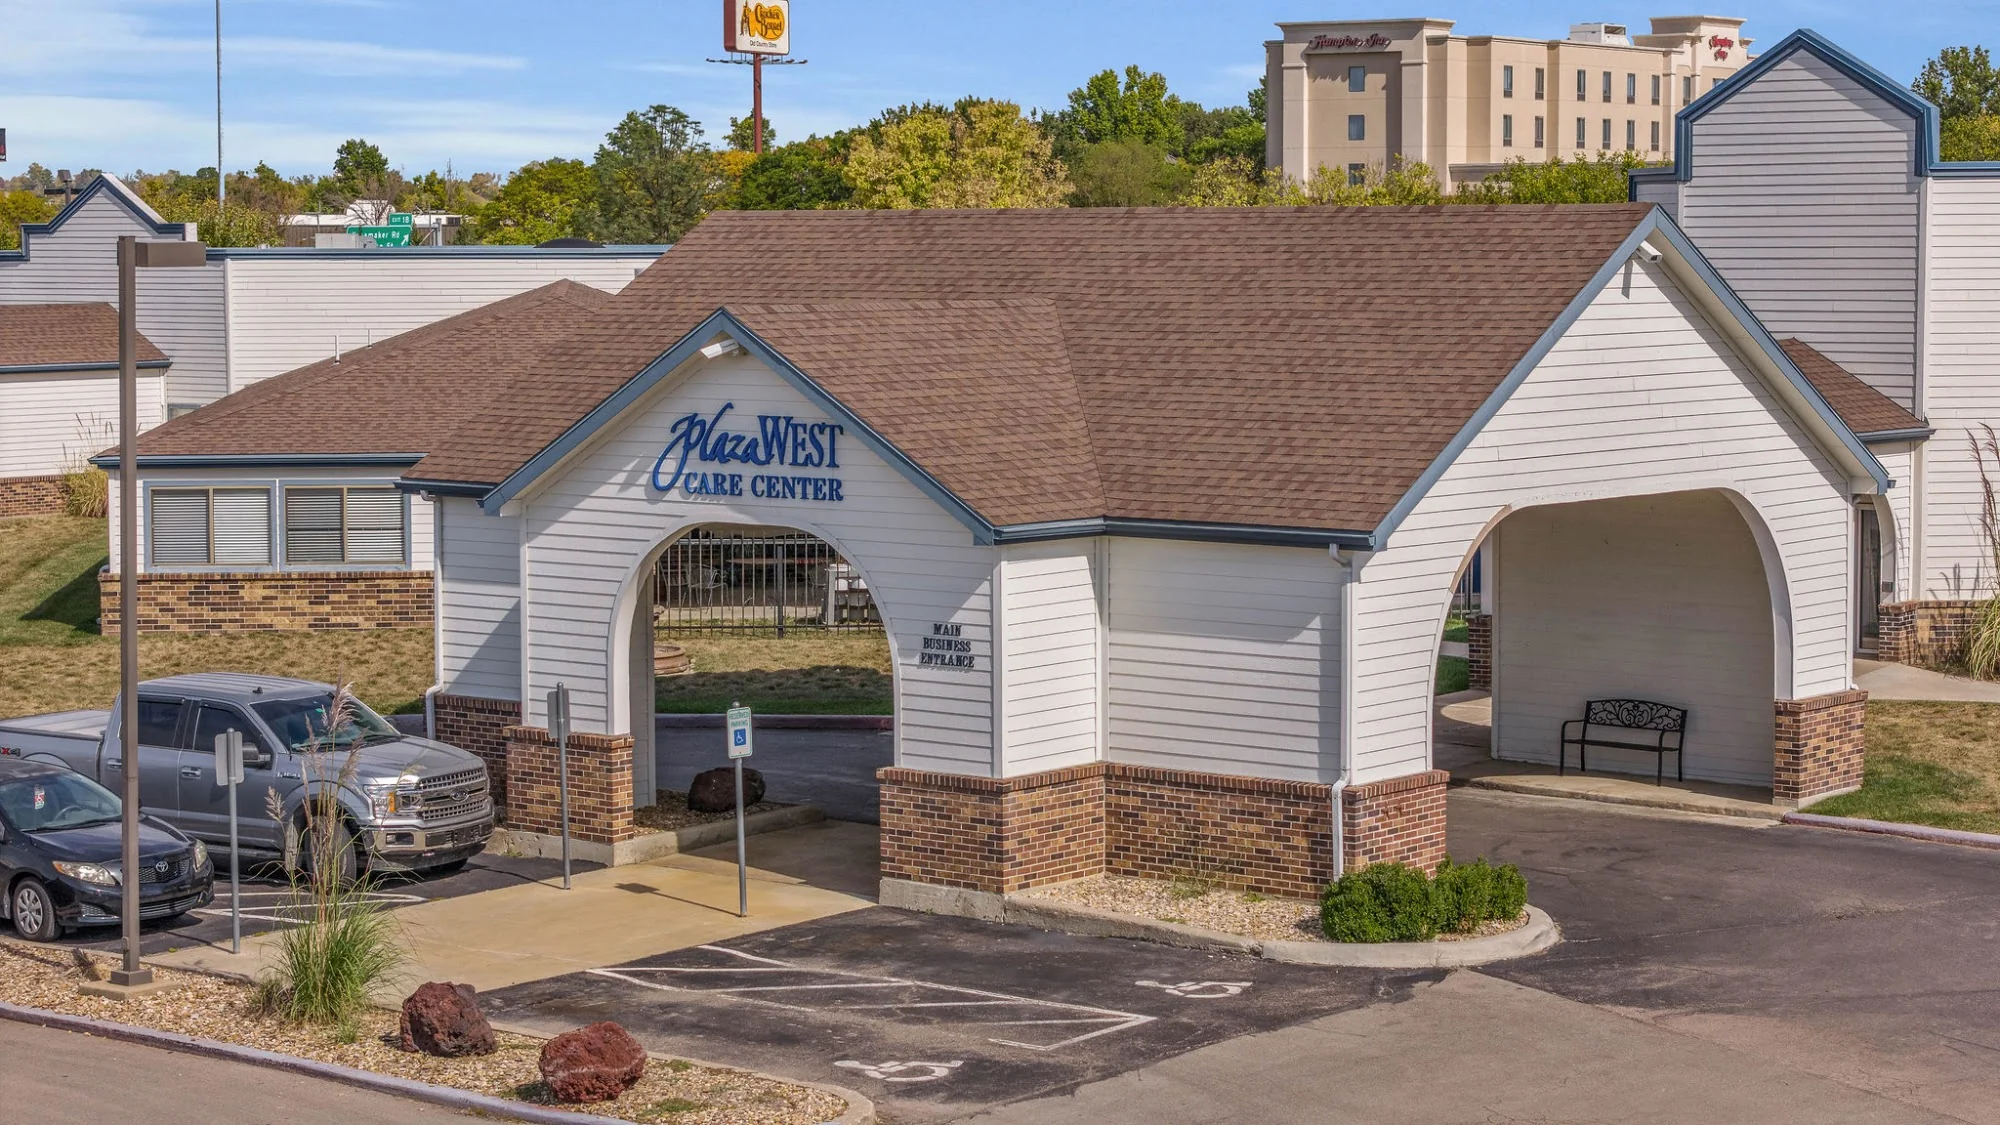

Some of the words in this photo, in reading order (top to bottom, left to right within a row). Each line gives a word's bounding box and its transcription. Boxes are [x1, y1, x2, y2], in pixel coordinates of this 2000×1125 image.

[1309, 34, 1363, 50] Hampton
[1365, 33, 1392, 48] Inn
[391, 231, 400, 239] Rd
[684, 471, 743, 496] CARE
[750, 474, 844, 501] CENTER
[933, 623, 962, 637] MAIN
[922, 637, 971, 653] BUSINESS
[920, 652, 975, 668] ENTRANCE
[729, 711, 749, 719] RESERVED
